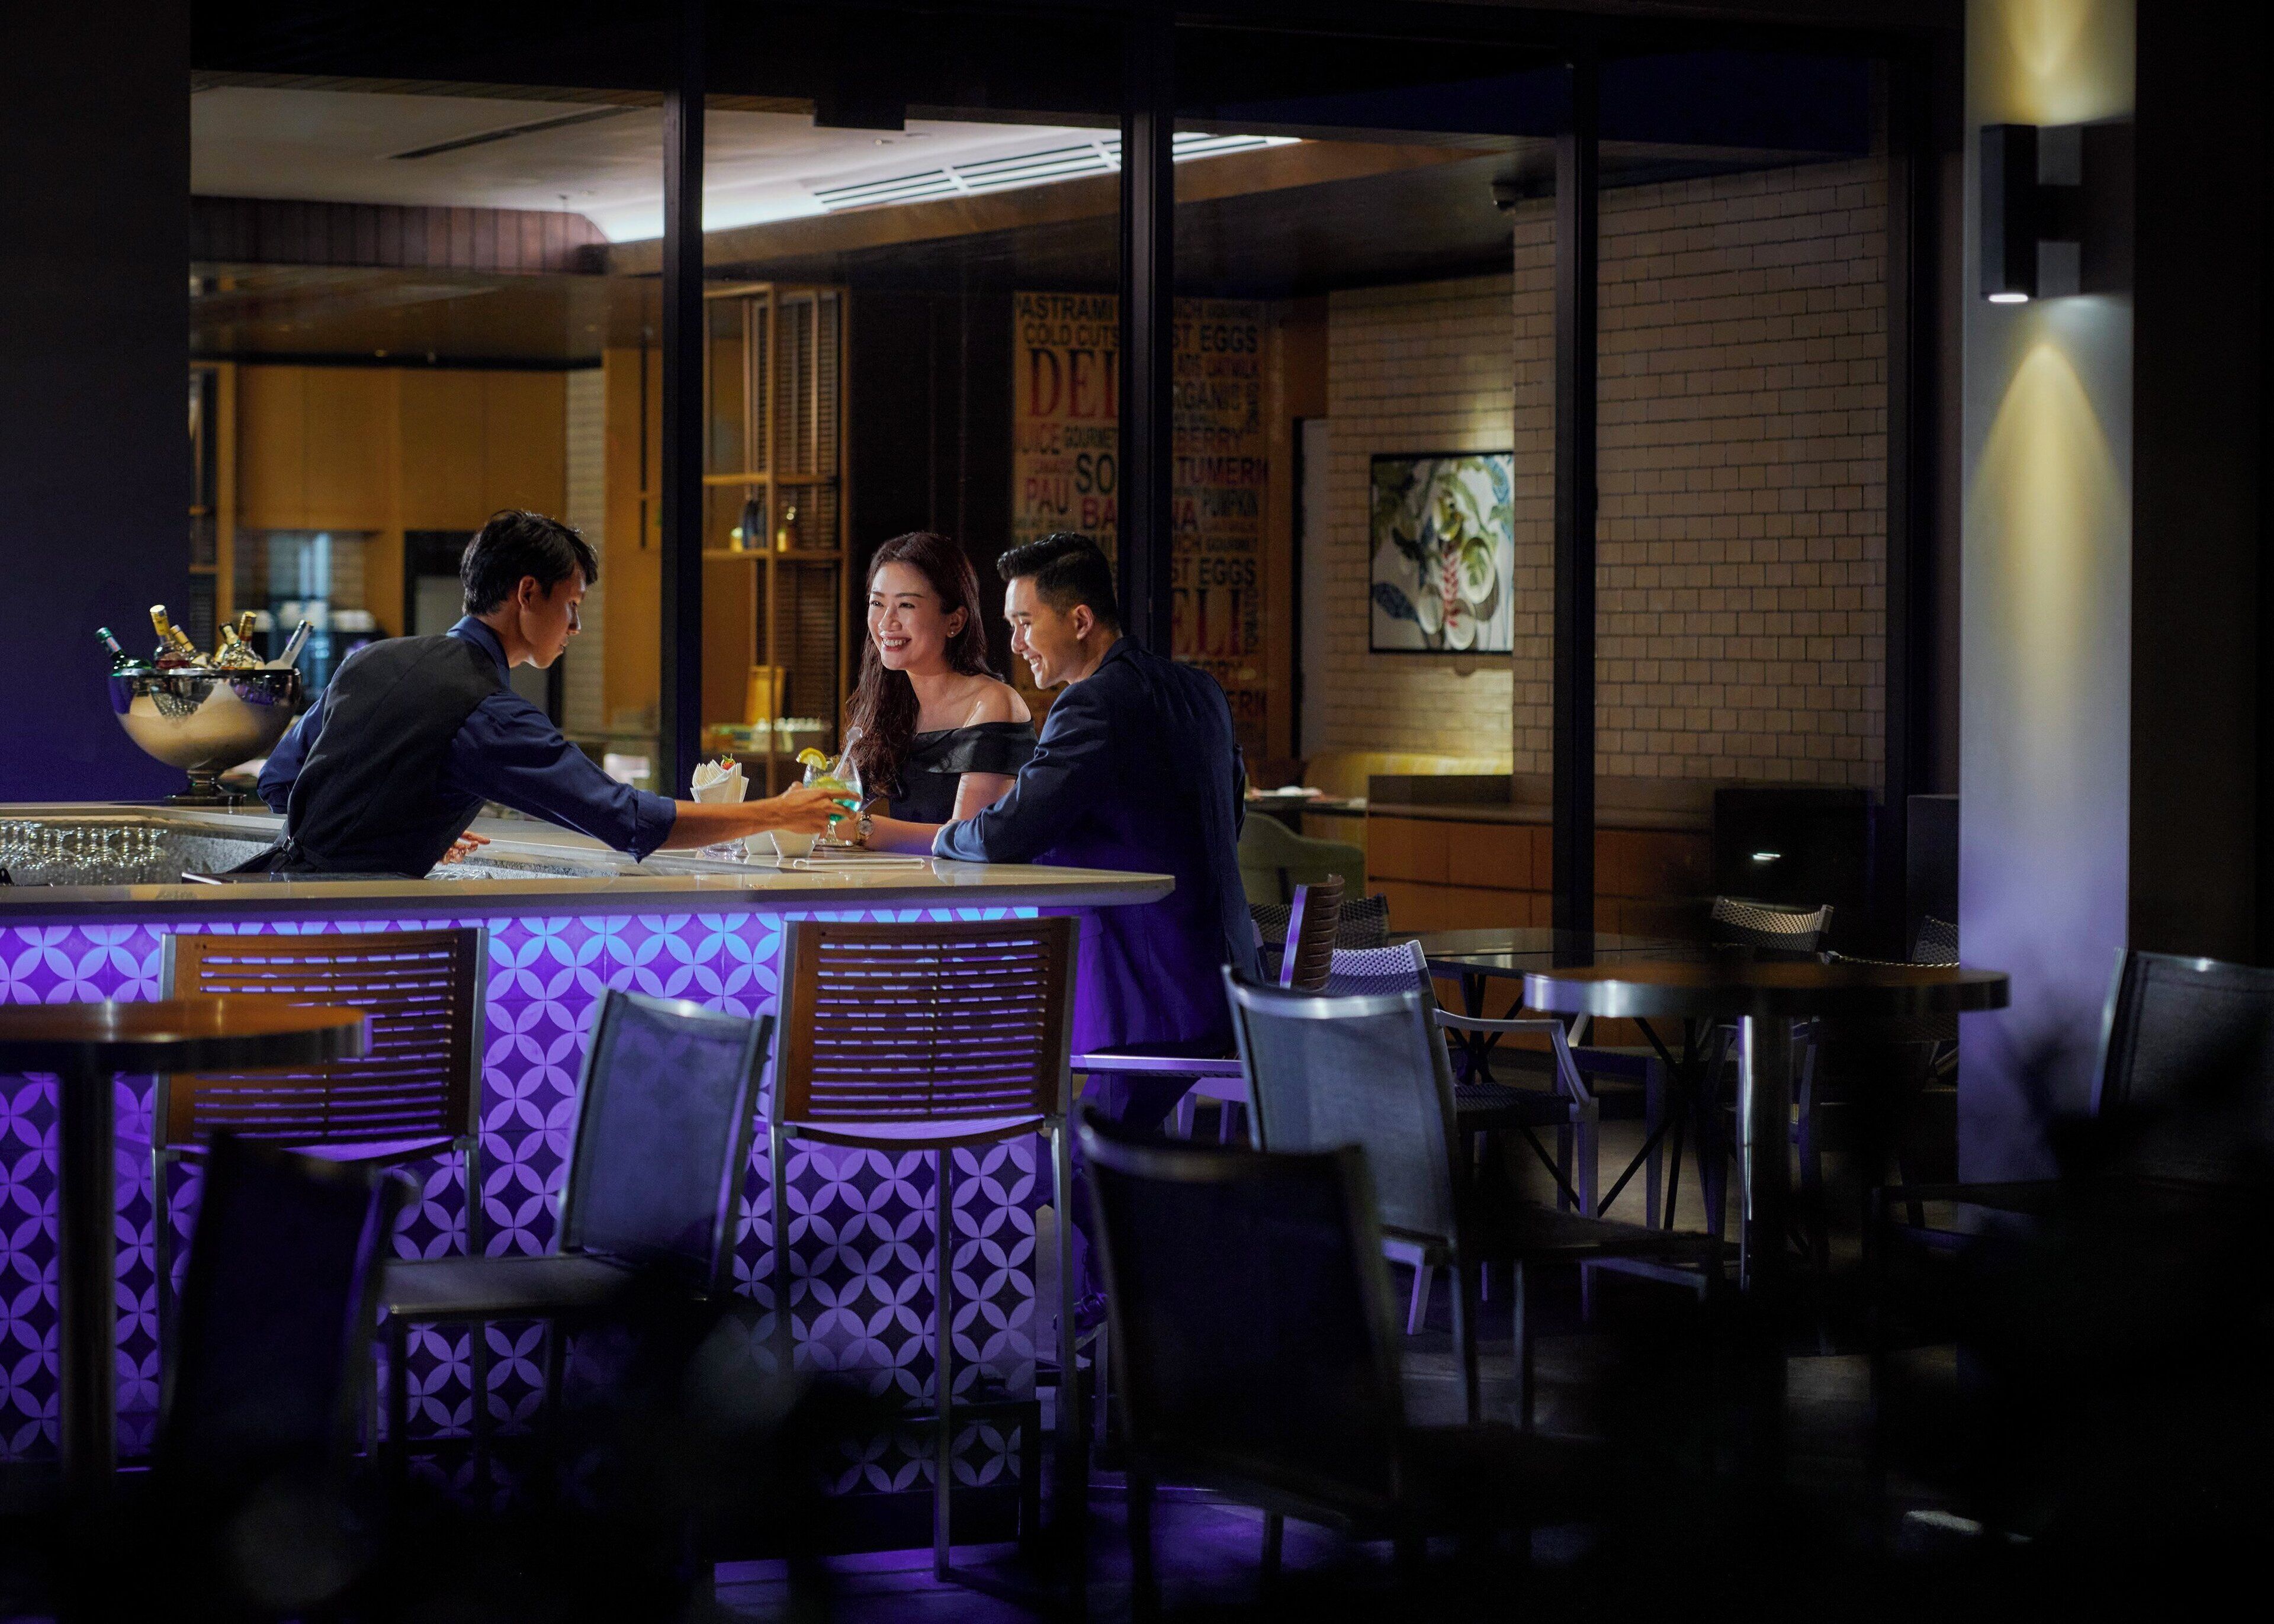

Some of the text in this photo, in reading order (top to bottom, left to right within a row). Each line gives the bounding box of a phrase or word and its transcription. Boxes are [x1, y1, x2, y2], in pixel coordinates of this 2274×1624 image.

[1024, 323, 1072, 346] COLD
[1200, 324, 1257, 353] EGGS
[1075, 452, 1115, 495] SO
[1026, 477, 1069, 516] PAU
[1082, 497, 1116, 530] BA
[1199, 557, 1256, 588] EGGS
